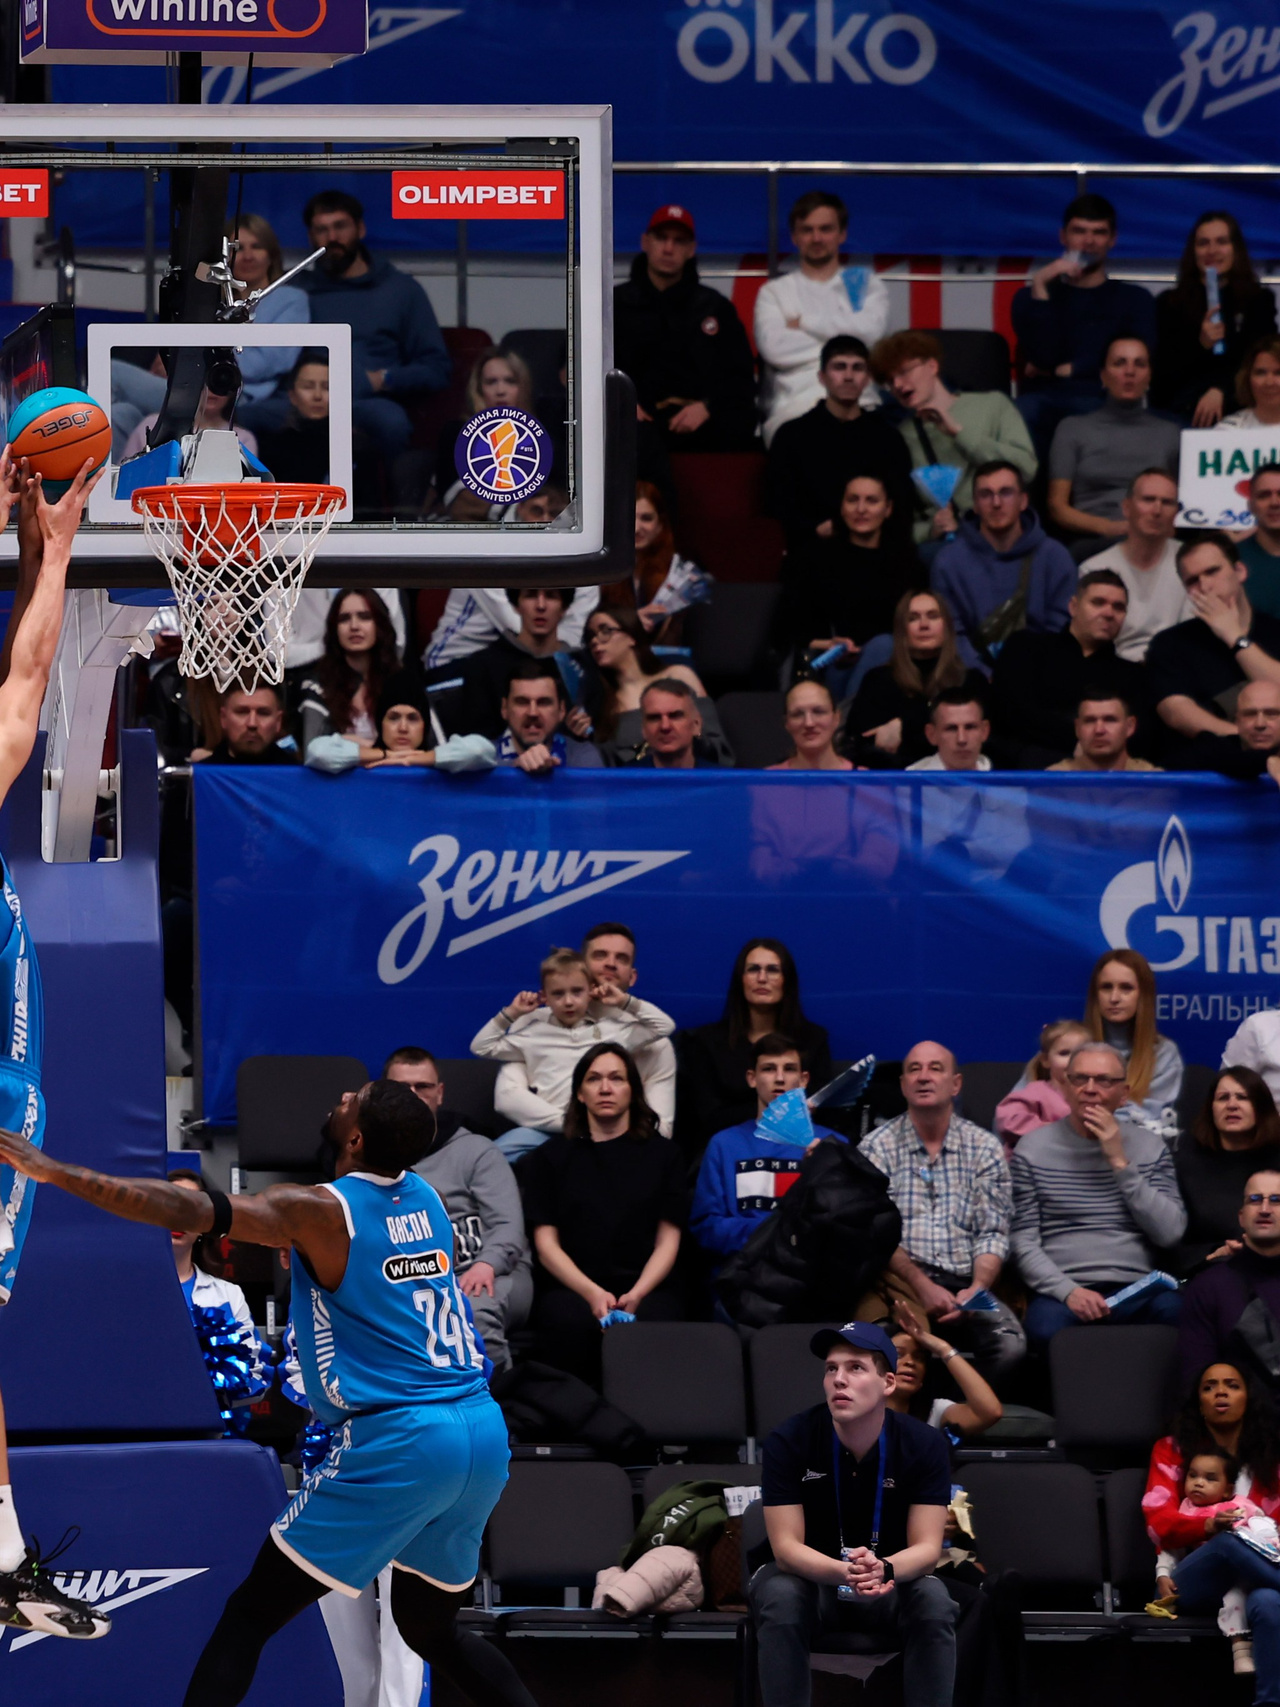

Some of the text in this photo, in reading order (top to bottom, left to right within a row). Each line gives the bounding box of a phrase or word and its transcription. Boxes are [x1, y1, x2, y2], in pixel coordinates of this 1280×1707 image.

[398, 185, 558, 205] OLIMPBET
[462, 408, 545, 438] ЕДИНАЯ ЛИГА ВТБ
[462, 472, 546, 503] VTB UNITED LEAGUE
[376, 833, 693, 985] Зенит
[739, 1159, 799, 1170] TOMM
[385, 1209, 434, 1245] BACON
[412, 1286, 466, 1368] 24
